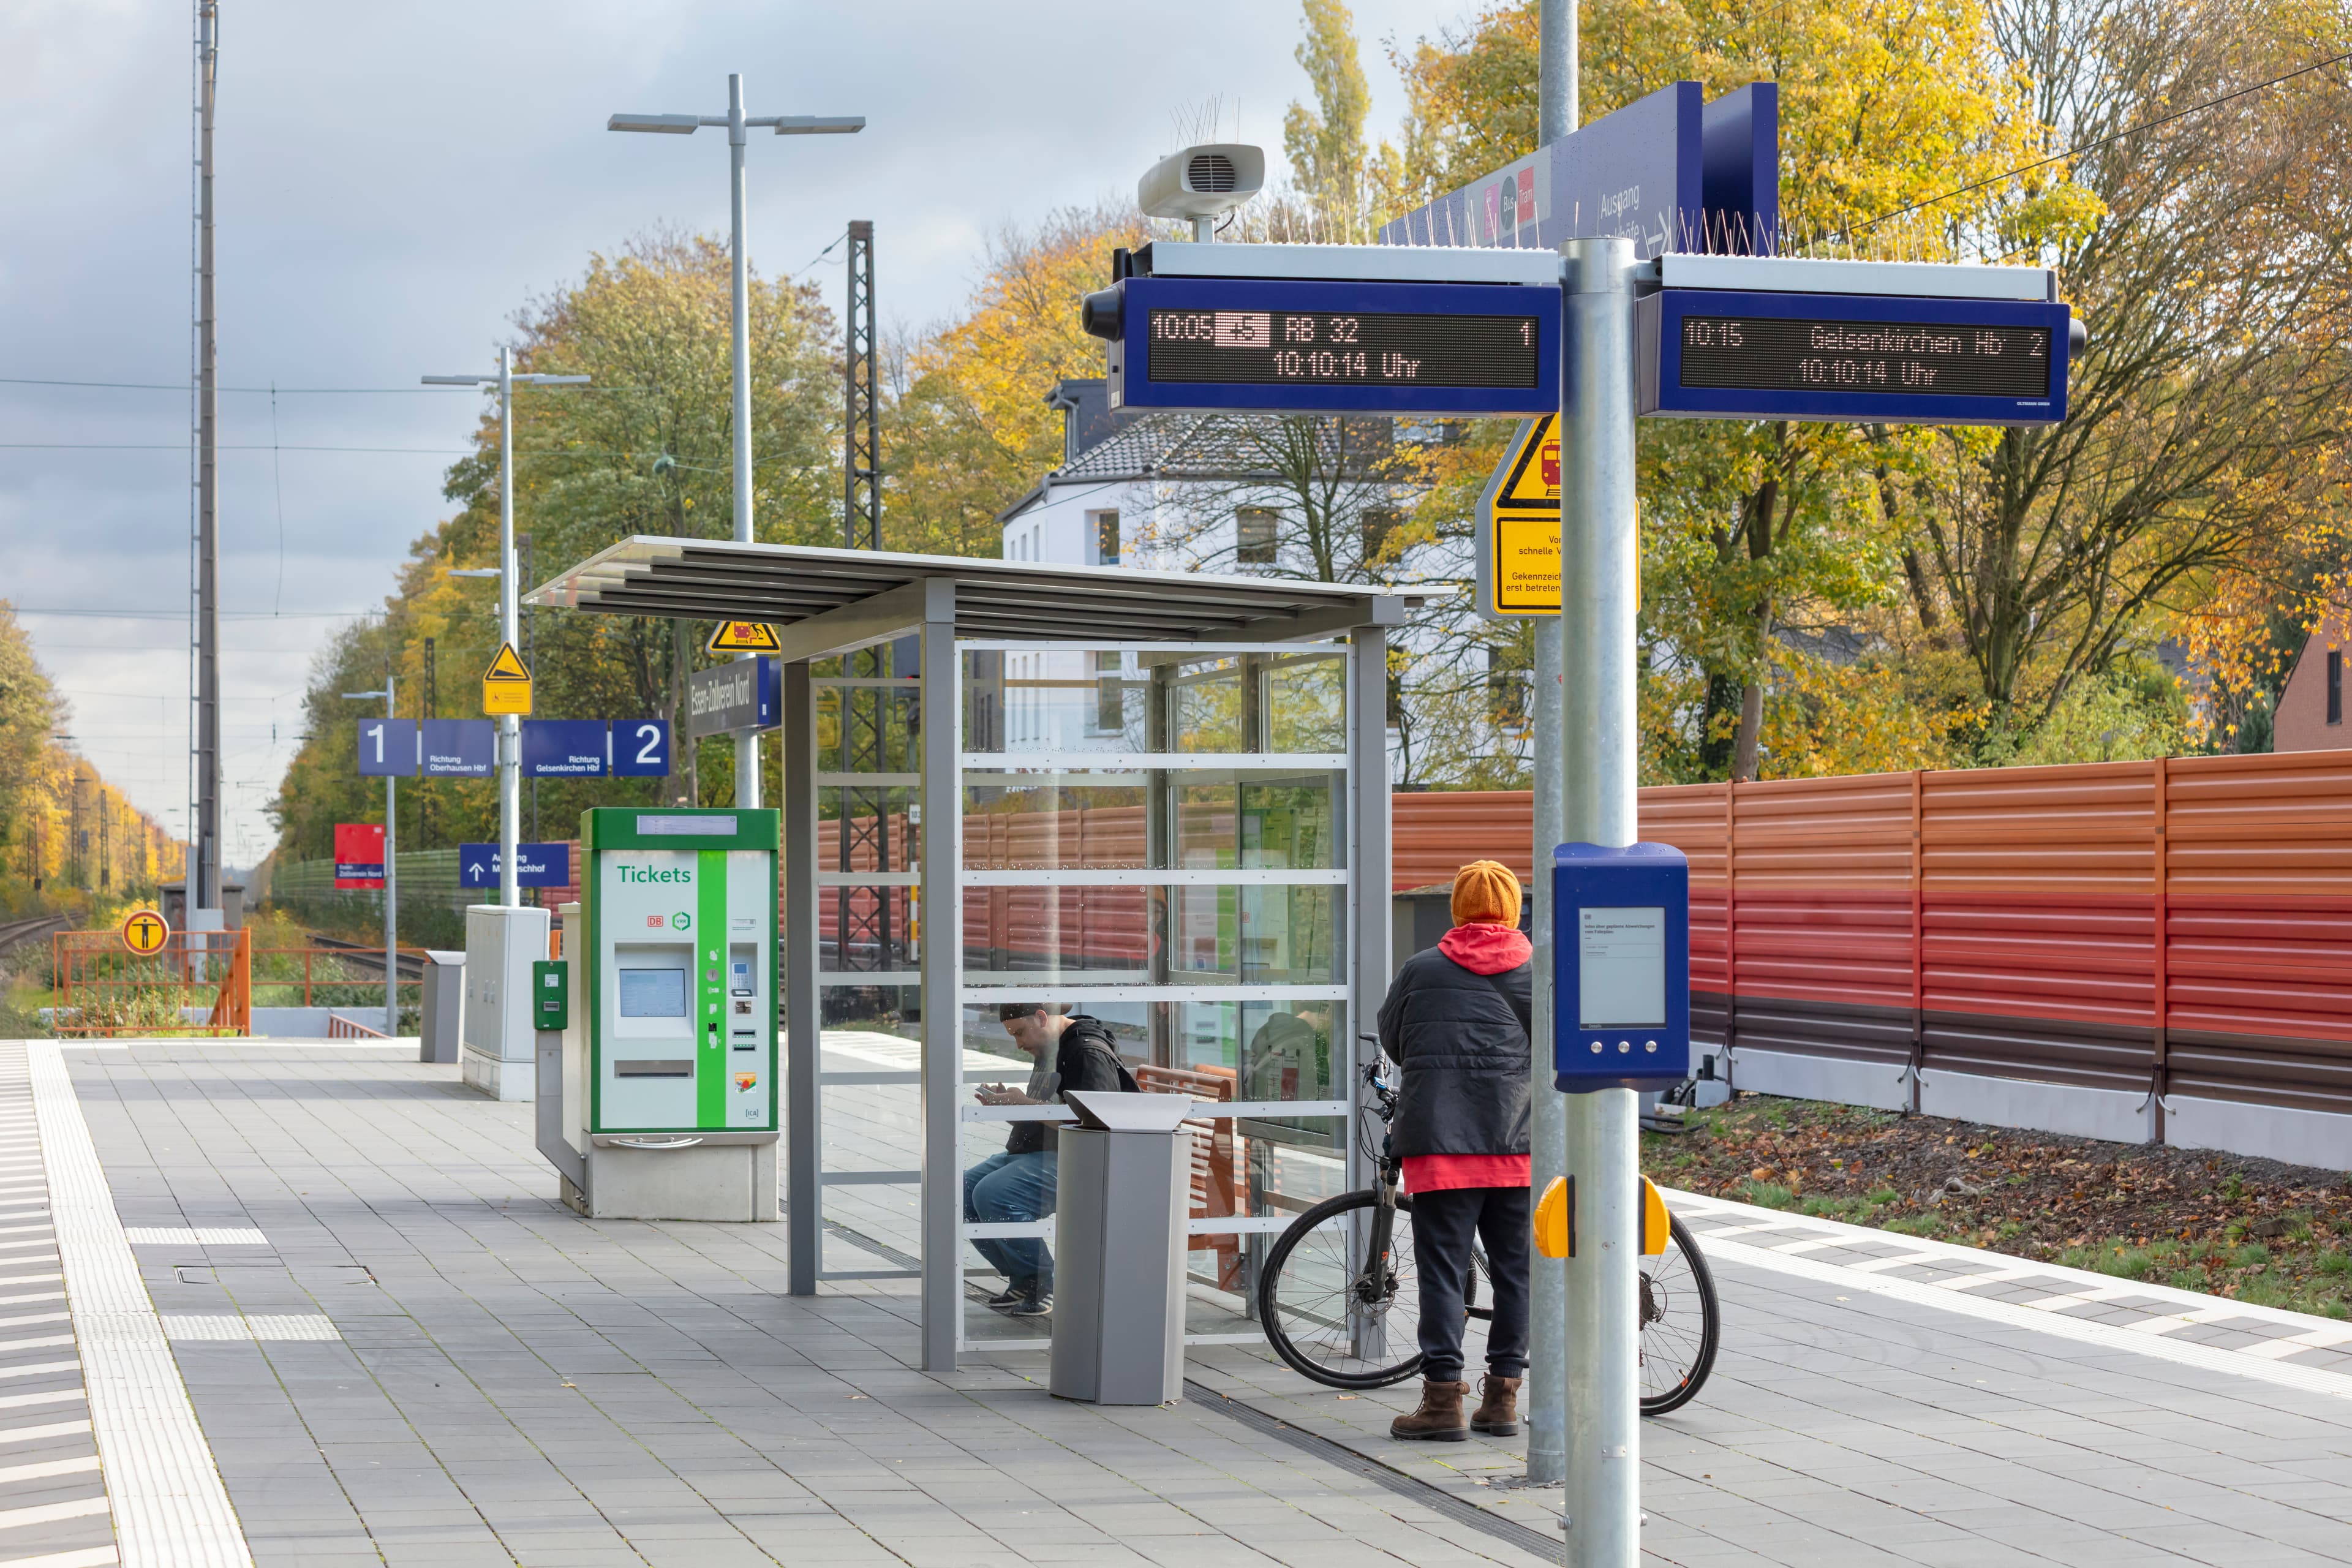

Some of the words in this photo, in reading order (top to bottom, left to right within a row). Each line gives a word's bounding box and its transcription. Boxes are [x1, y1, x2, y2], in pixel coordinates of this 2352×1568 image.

[1504, 195, 1514, 212] Bus
[1519, 188, 1533, 205] Tram
[1600, 185, 1640, 219] Ausgang
[1153, 314, 1213, 339] 10:05
[1286, 317, 1314, 341] RB
[1330, 317, 1358, 342] 32
[1520, 322, 1529, 345] 1
[1686, 322, 1743, 346] 10:15
[1811, 326, 1961, 353] Gelsenkirchen
[2030, 333, 2043, 356] 2
[1273, 351, 1366, 376] 10:10:14
[1382, 353, 1420, 377] Uhr
[1799, 358, 1887, 383] 10:10:14
[1902, 362, 1937, 385] Uhr
[1518, 546, 1553, 555] schnelle
[692, 676, 734, 715] Essen-Zollverein
[735, 671, 749, 706] Nord
[368, 724, 383, 763] 1
[636, 725, 661, 764] 2
[430, 755, 461, 764] Richtung
[569, 755, 600, 764] Richtung
[617, 864, 691, 883] Tickets
[649, 917, 662, 925] DB
